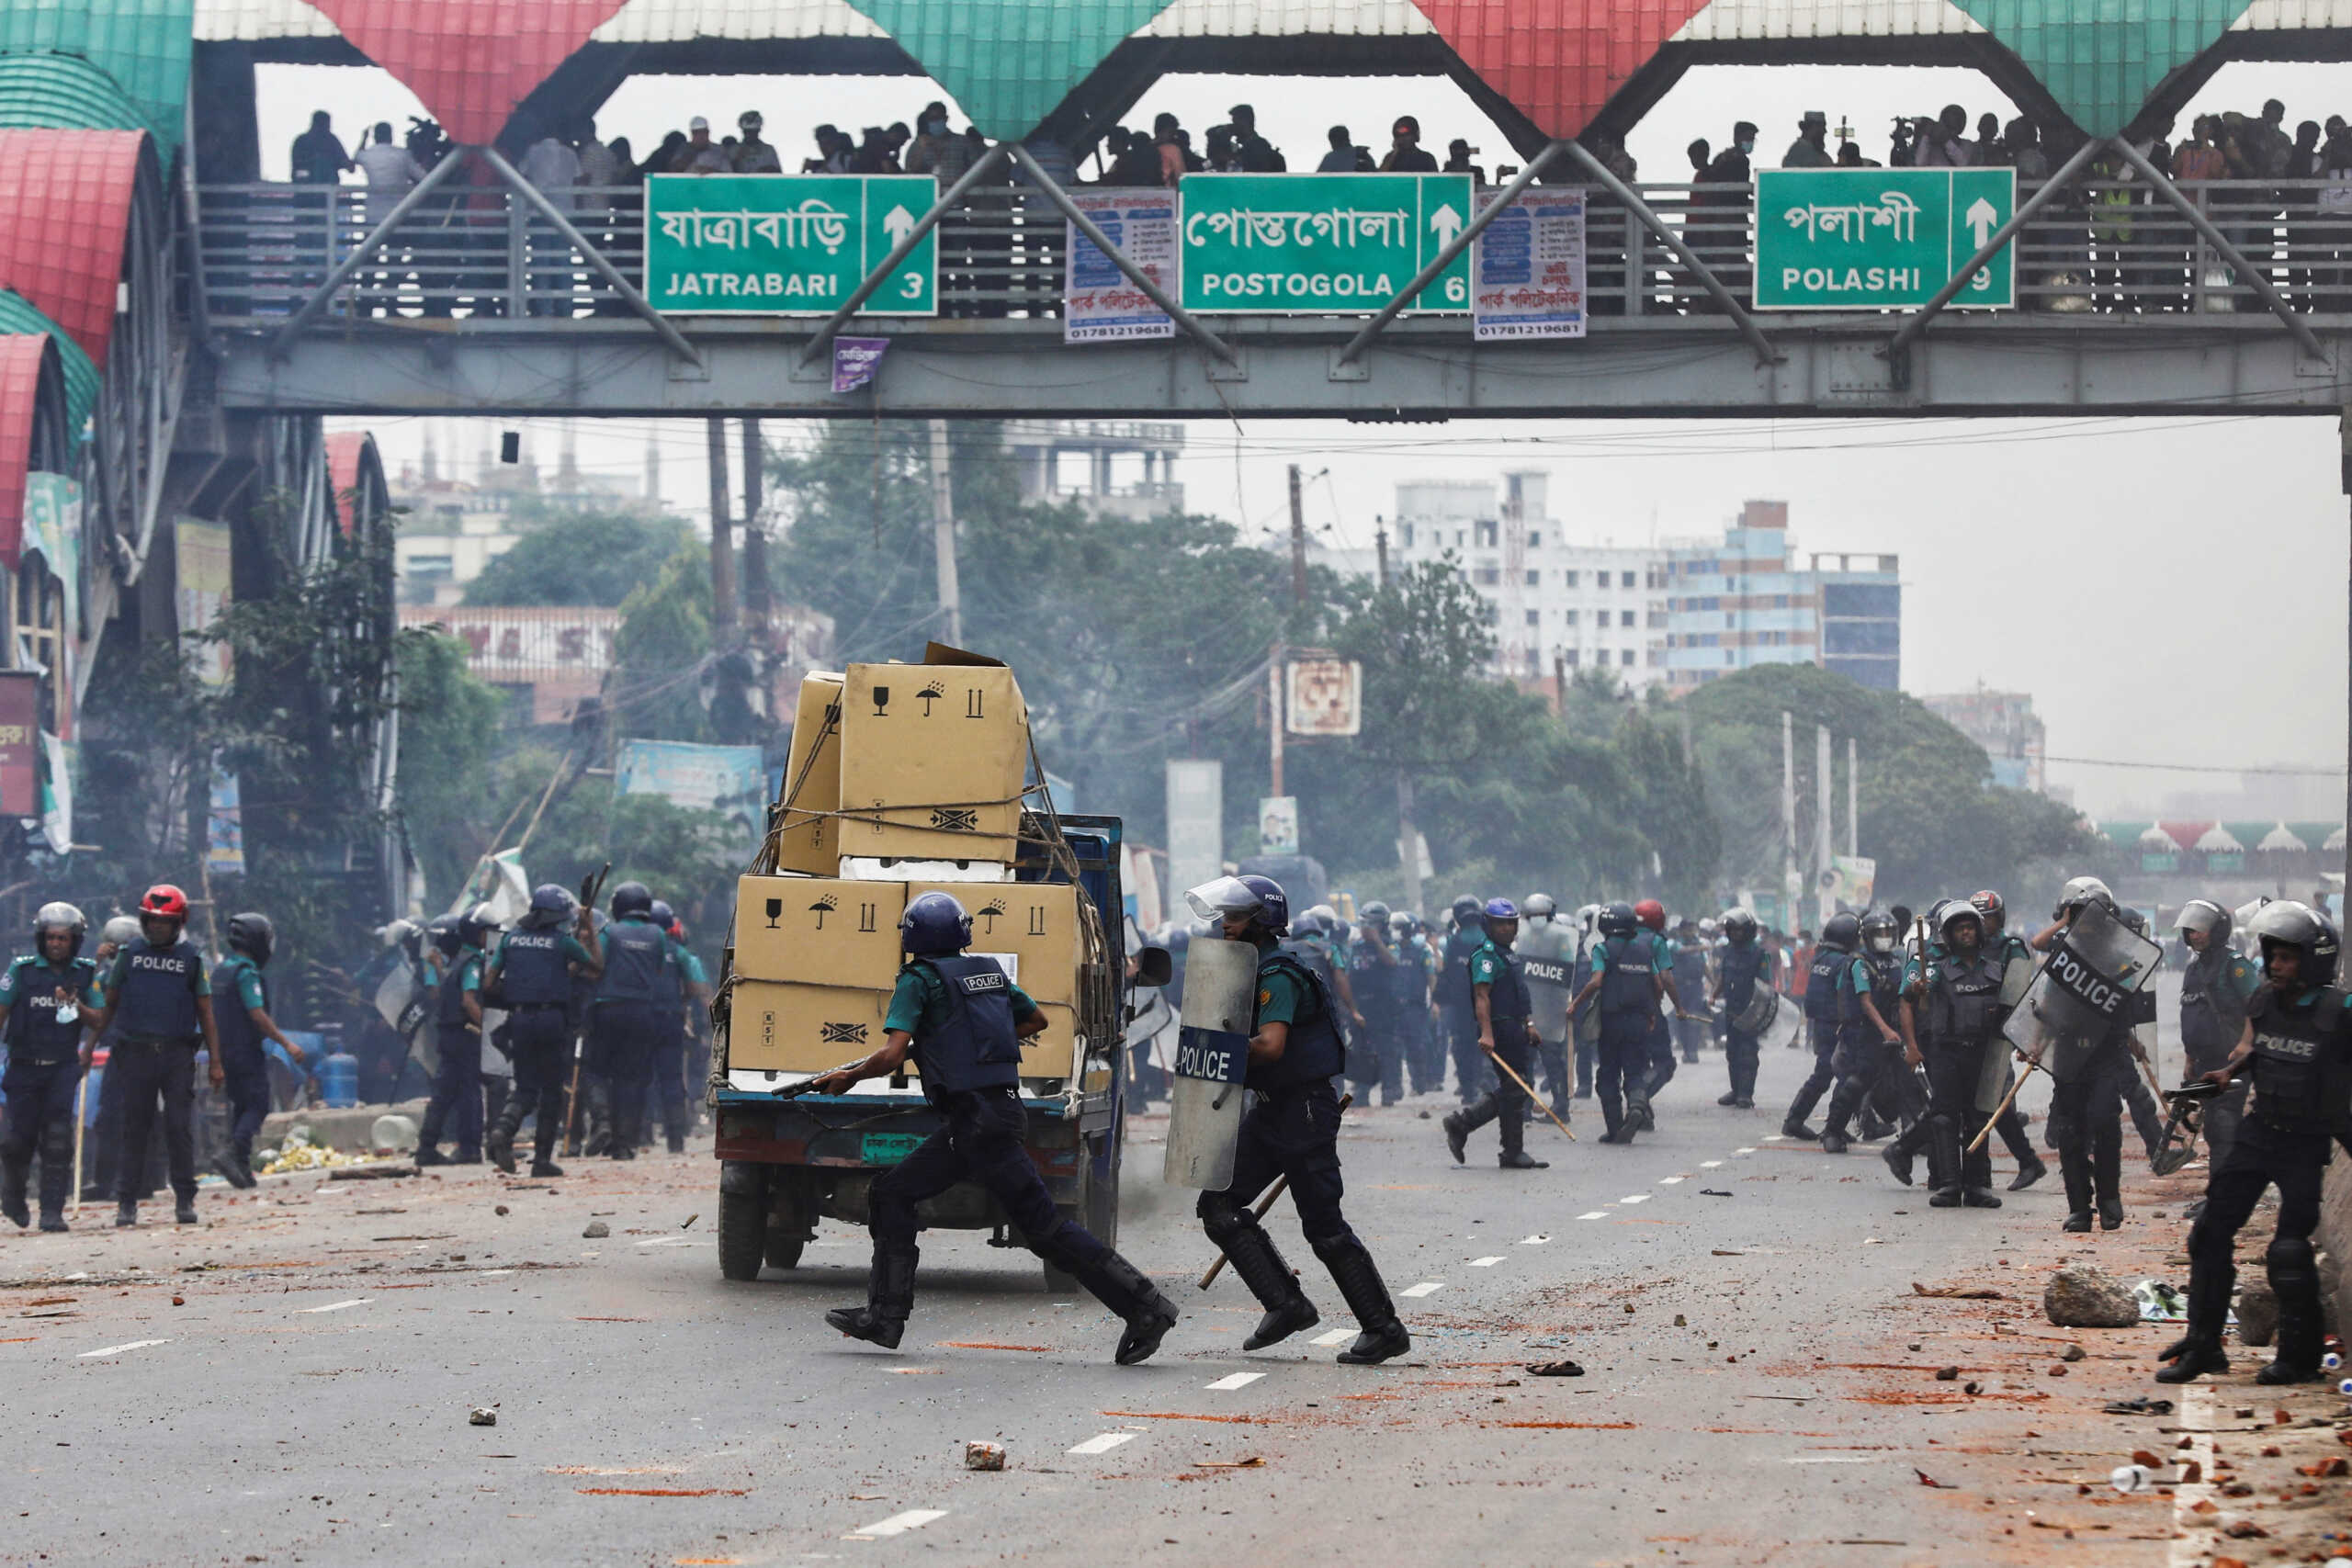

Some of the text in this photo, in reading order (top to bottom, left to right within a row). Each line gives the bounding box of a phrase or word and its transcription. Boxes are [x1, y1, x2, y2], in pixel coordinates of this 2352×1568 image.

[655, 198, 851, 255] যাত্রাবাড়ি
[1186, 207, 1409, 249] পোস্তগোলা
[1783, 191, 1922, 243] পলাশী
[665, 273, 837, 297] JATRABARI
[899, 272, 923, 299] 3
[1203, 273, 1394, 297] POSTOGOLA
[1444, 276, 1465, 302] 6
[1782, 267, 1920, 291] POLASHI
[1972, 266, 1991, 291] 9
[1071, 325, 1170, 338] 01781219681
[1478, 324, 1579, 336] 01781219681
[510, 936, 552, 949] POLICE
[131, 955, 186, 973] POLICE
[1524, 962, 1565, 981] POLICE
[968, 976, 1000, 988] POLICE
[2051, 951, 2122, 1013] POLICE
[2255, 1033, 2316, 1056] POLICE
[1180, 1045, 1231, 1081] POLICE
